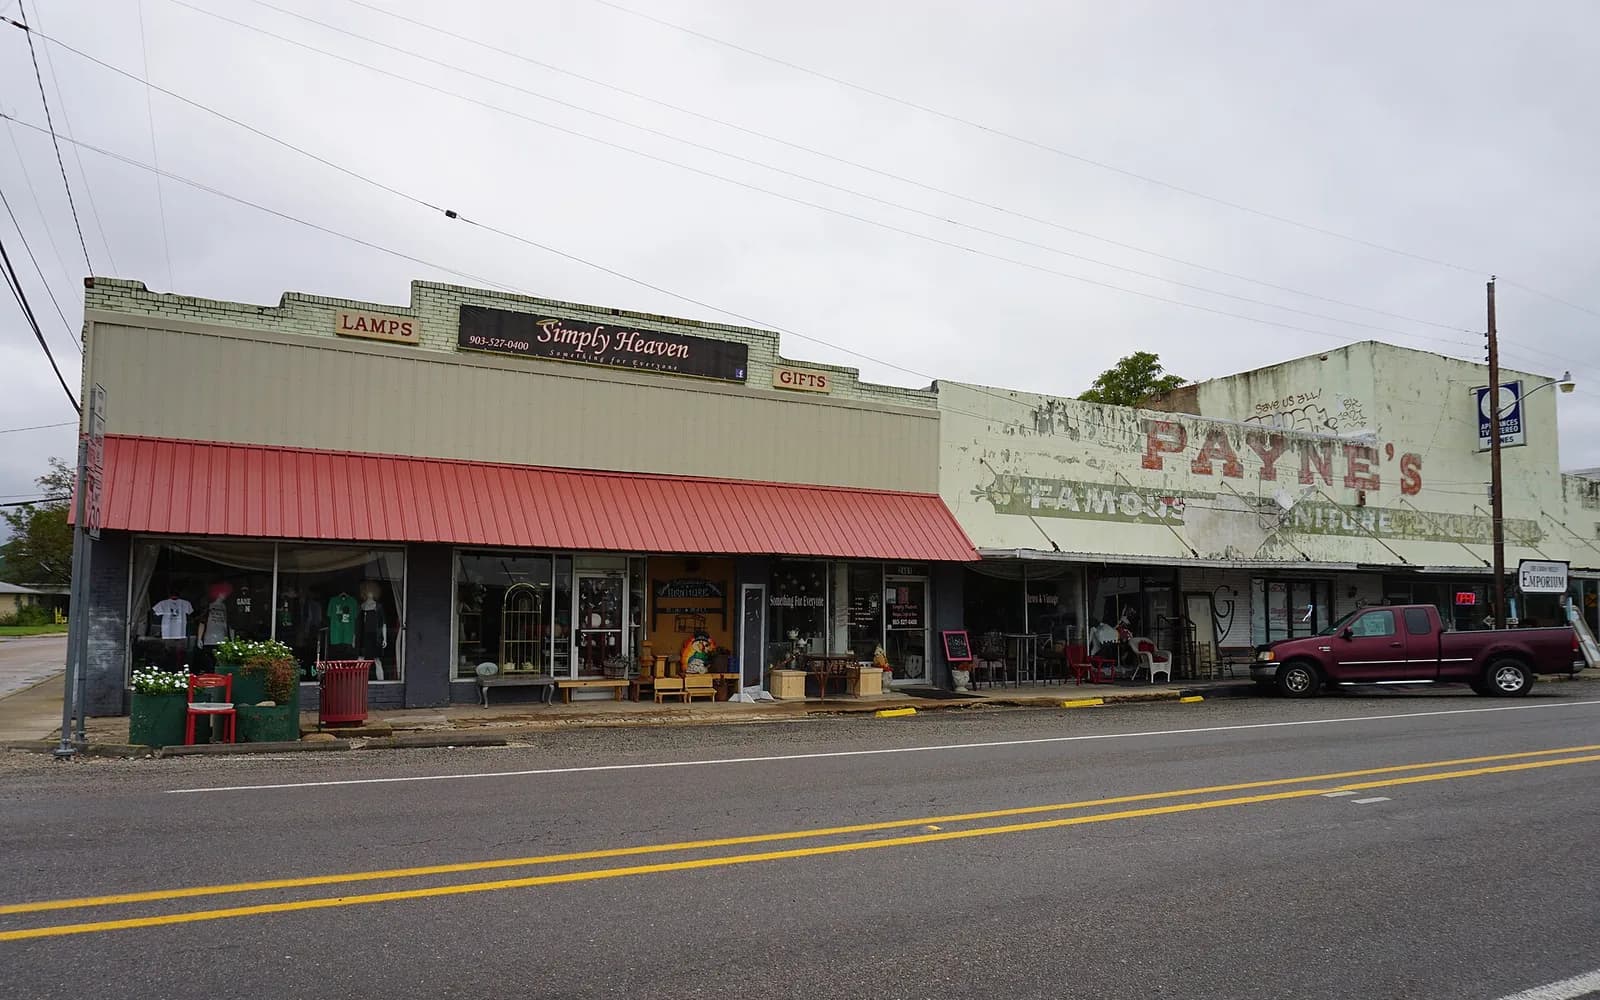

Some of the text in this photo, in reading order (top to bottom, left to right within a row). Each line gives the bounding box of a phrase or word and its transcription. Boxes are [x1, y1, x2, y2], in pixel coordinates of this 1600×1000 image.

[341, 314, 413, 337] LAMPS
[469, 335, 529, 351] 903-527-0400
[536, 320, 689, 359] Simply Heaven
[548, 349, 678, 371] Something for Everyone
[779, 371, 826, 388] GIFTS
[1141, 418, 1423, 496] PAYNE'S
[1521, 570, 1565, 588] EMPORIUM
